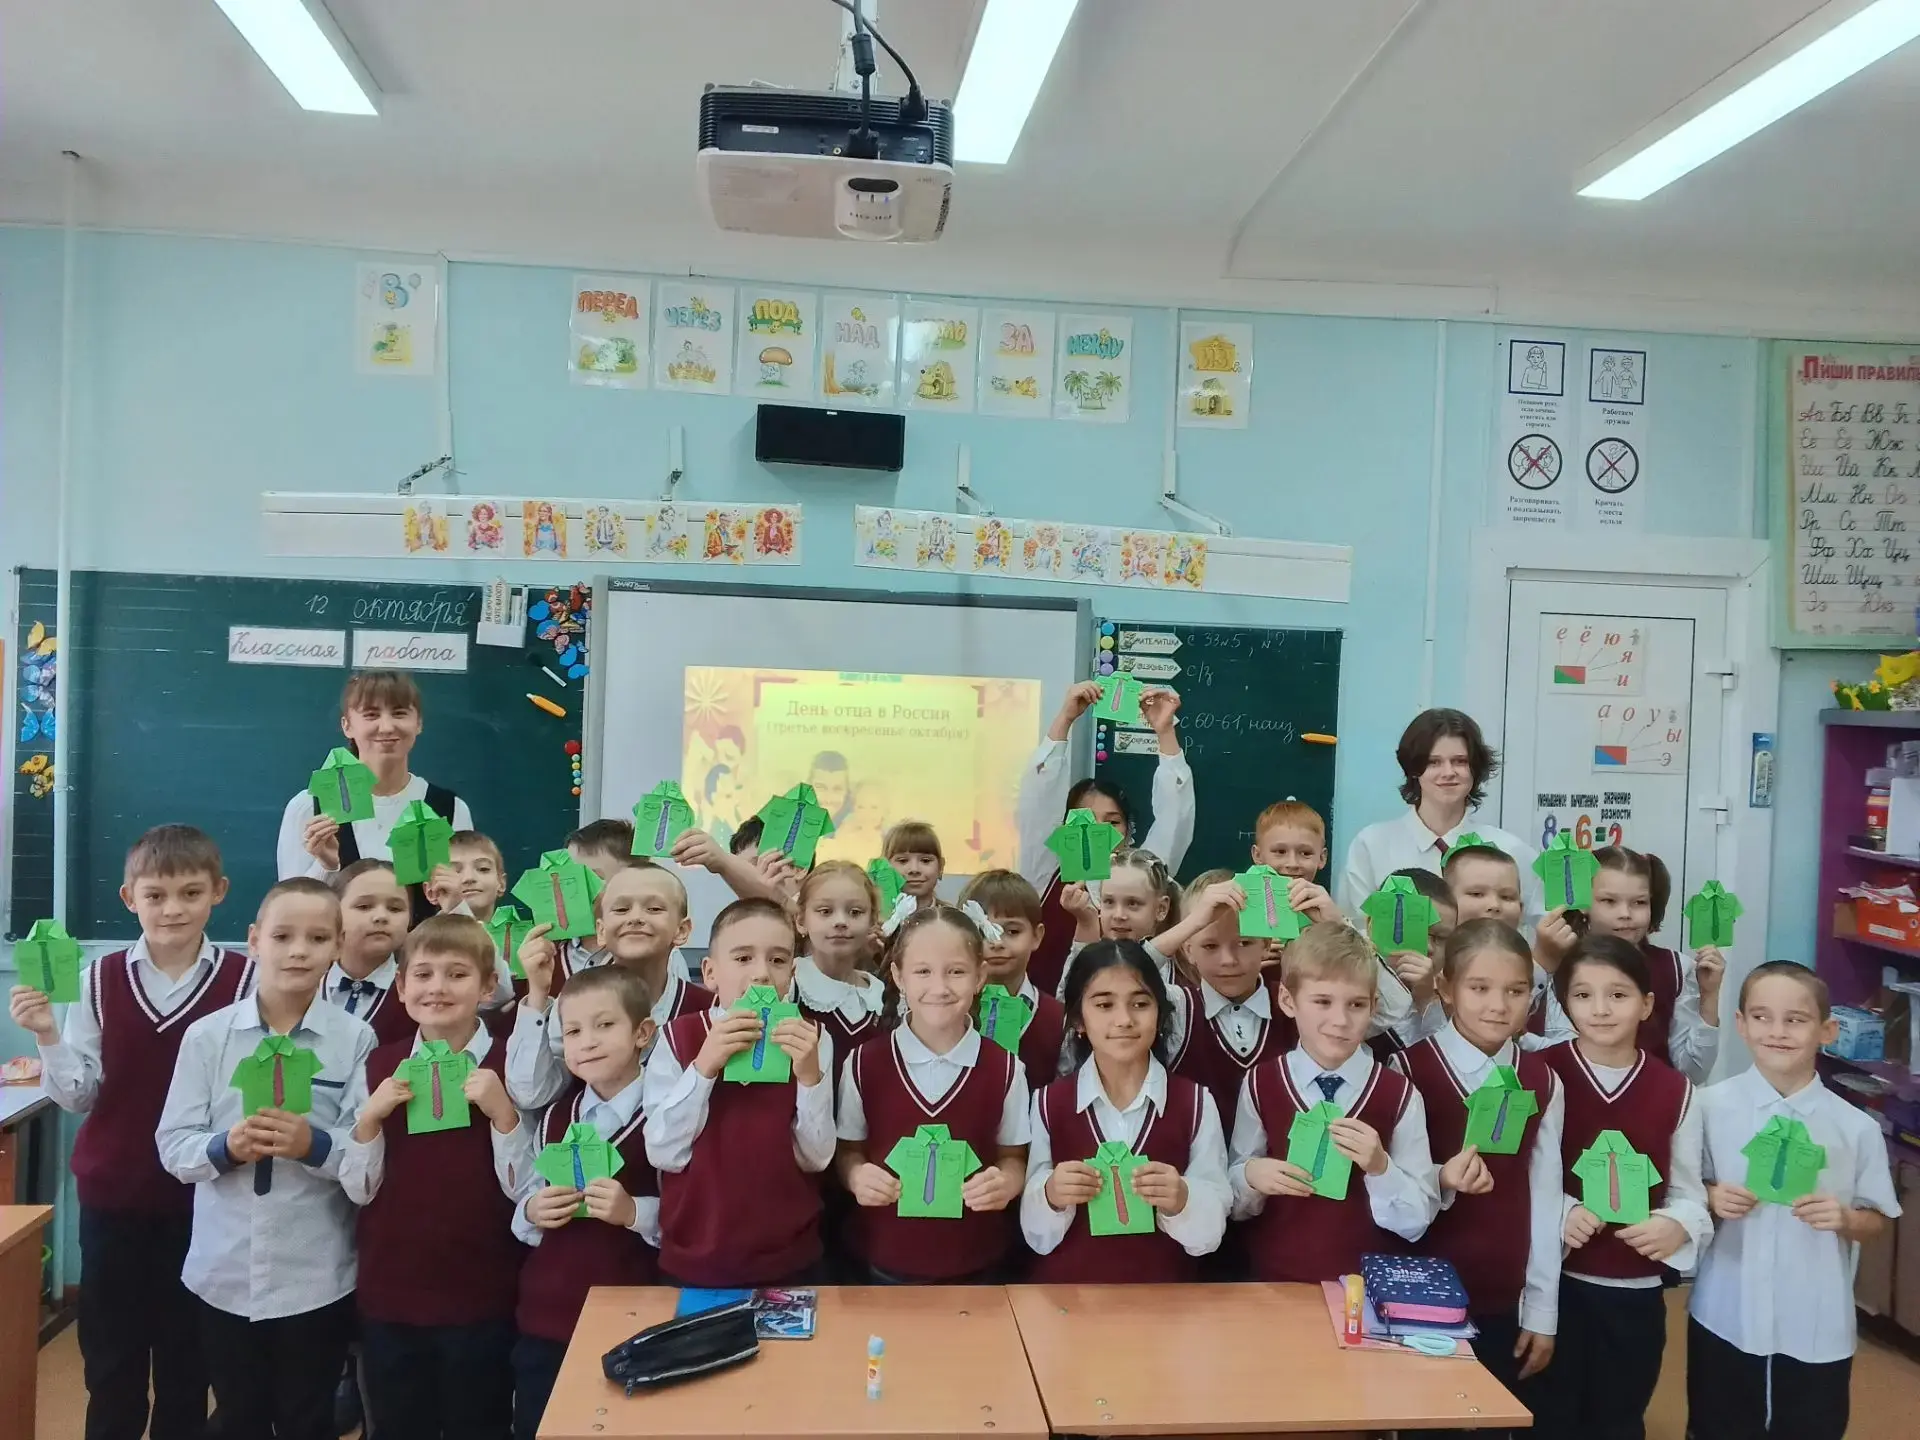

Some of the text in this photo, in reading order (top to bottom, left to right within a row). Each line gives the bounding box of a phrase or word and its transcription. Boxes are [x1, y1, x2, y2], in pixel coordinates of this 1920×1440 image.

[578, 290, 639, 320] ПЕРЕД
[755, 298, 801, 323] ПОД
[664, 304, 722, 332] ЧЕРЕЗ
[835, 321, 880, 349] НАД
[1000, 322, 1035, 353] ЗА
[304, 594, 329, 615] 12
[231, 631, 340, 658] Классная
[364, 636, 456, 665] работа
[1604, 632, 1621, 646] ю
[1620, 650, 1633, 663] я
[1617, 674, 1629, 687] и
[786, 700, 829, 716] День
[833, 705, 872, 719] отца
[878, 708, 887, 718] в
[1601, 808, 1632, 823] разности
